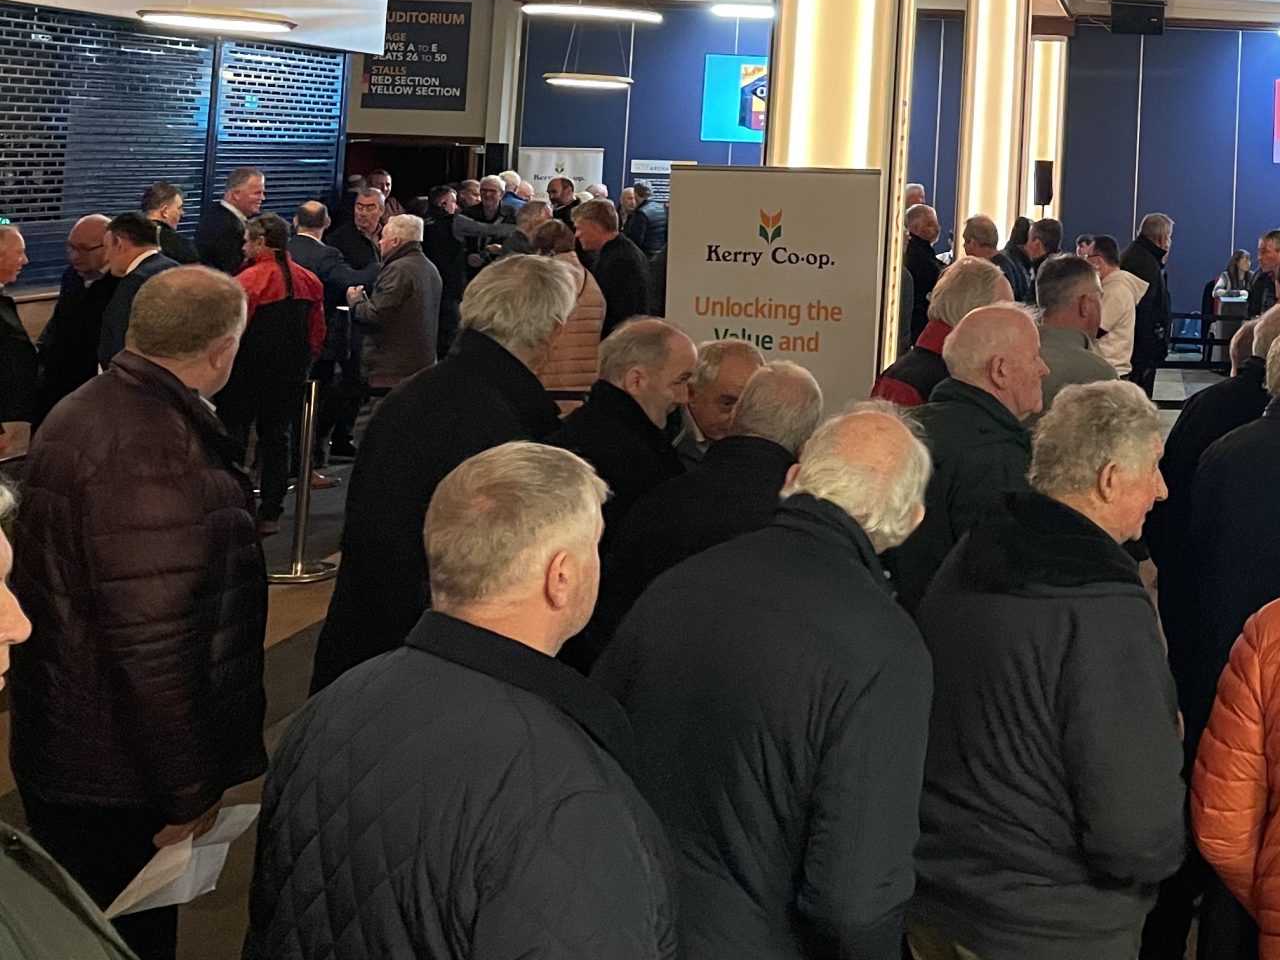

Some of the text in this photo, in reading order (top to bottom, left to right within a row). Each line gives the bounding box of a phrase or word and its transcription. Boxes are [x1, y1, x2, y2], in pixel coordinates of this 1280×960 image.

[387, 11, 464, 25] UDITORIUM
[386, 33, 406, 41] AGE
[407, 43, 414, 51] A
[431, 44, 437, 52] E
[406, 53, 418, 61] 26
[422, 54, 432, 62] TO
[435, 54, 447, 62] 50
[372, 66, 406, 74] STALLS
[371, 76, 439, 85] RED SECTION
[370, 85, 460, 96] YELLOW SECTION
[706, 245, 763, 266] Kerry
[695, 296, 842, 325] Unlocking the
[778, 331, 819, 352] and
